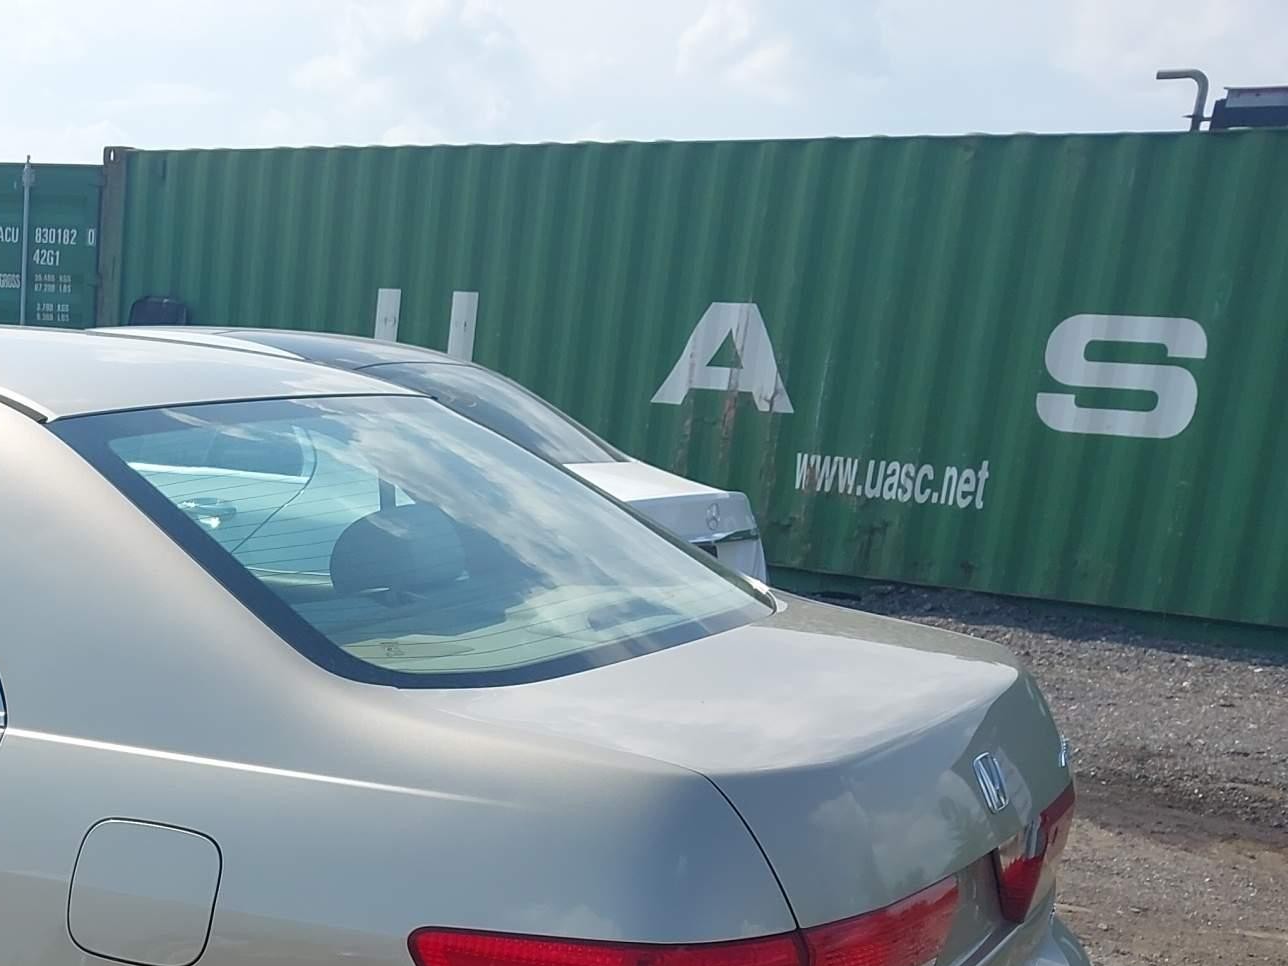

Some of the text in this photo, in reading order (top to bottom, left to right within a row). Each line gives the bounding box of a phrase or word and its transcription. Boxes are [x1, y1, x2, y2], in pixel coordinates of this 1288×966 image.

[35, 227, 78, 245] 830182
[33, 248, 60, 266] 42G1
[795, 453, 989, 509] www.uasc.net
